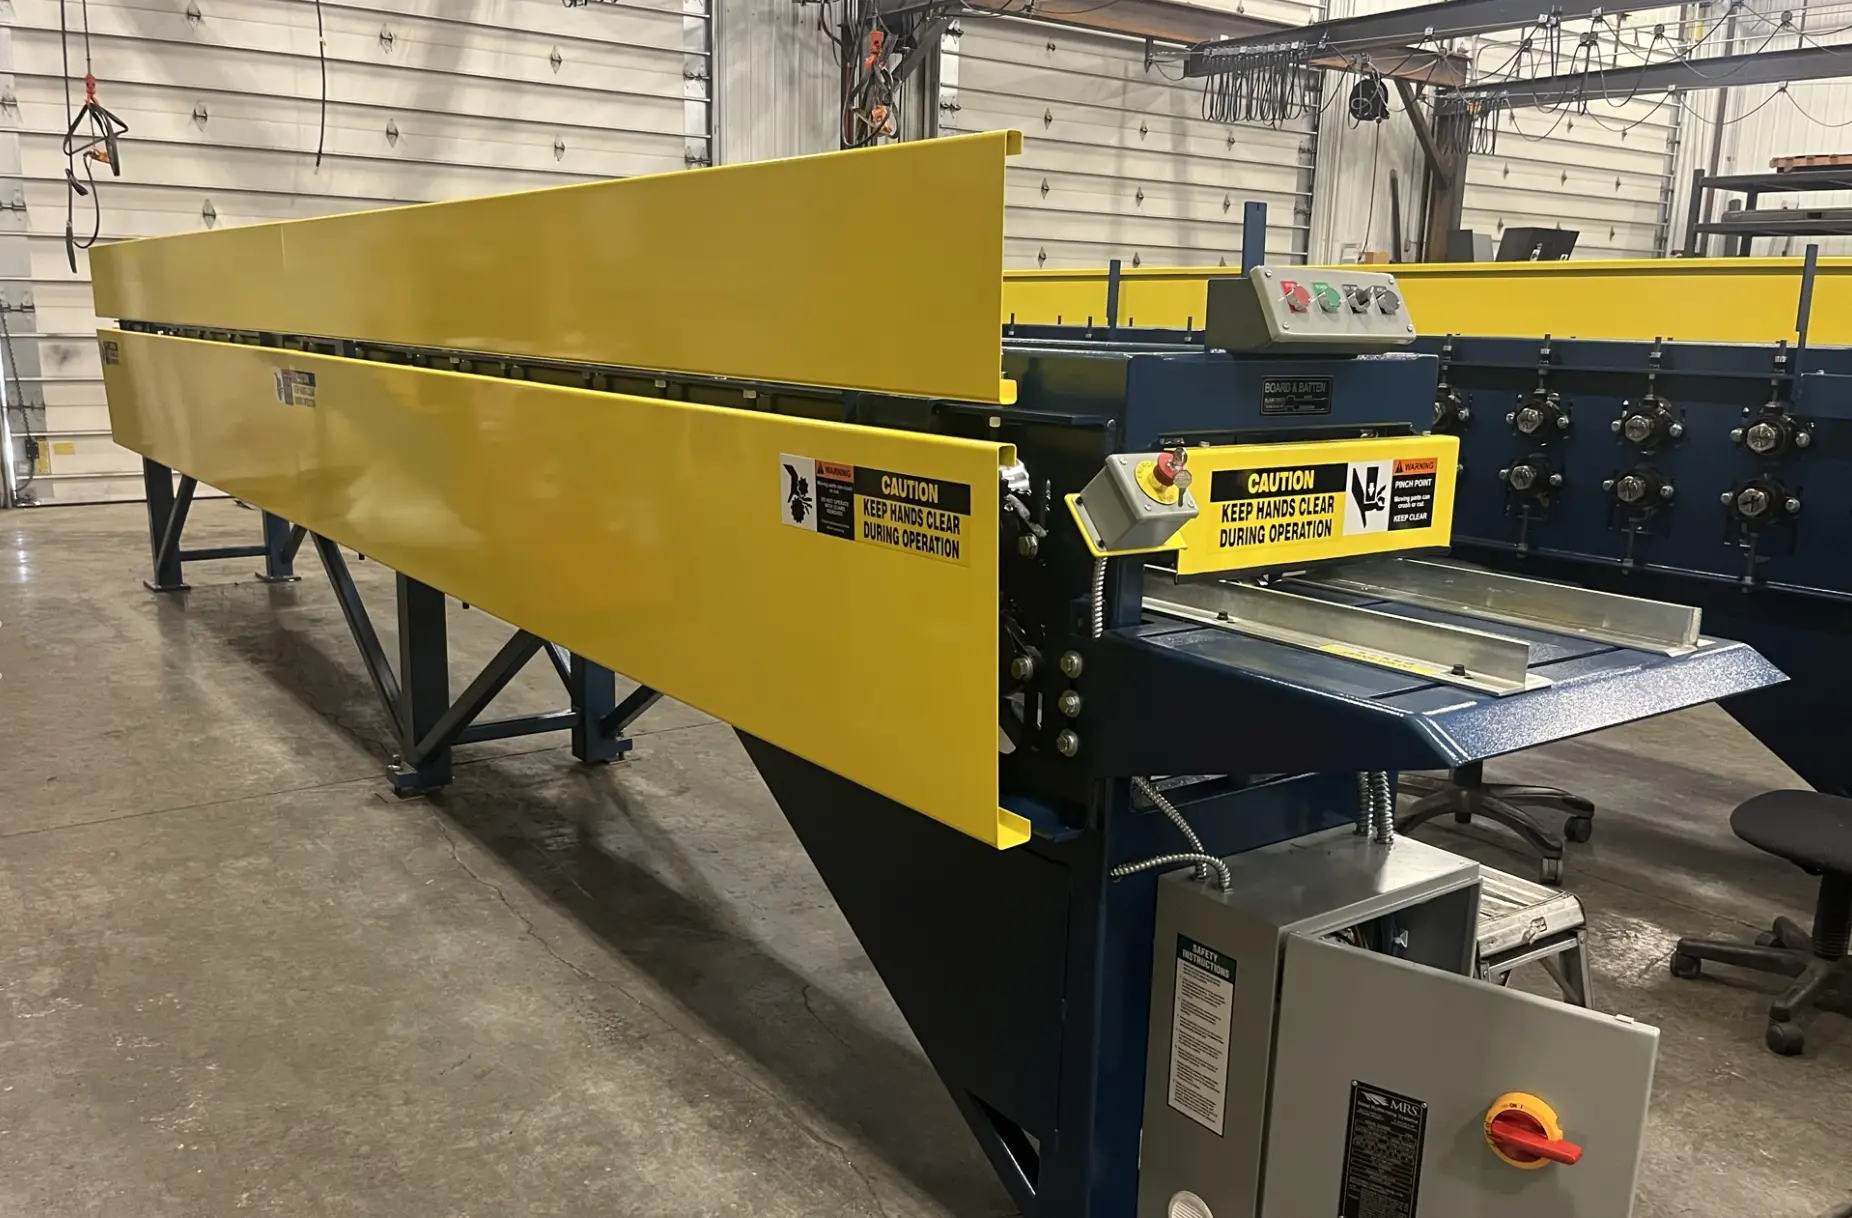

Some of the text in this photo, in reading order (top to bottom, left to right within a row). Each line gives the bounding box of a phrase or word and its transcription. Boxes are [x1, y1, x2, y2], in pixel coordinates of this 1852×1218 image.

[1265, 382, 1291, 393] BOARD
[1299, 382, 1326, 393] BATTEN
[825, 467, 851, 477] WARNING
[1405, 462, 1434, 471] WARNING
[881, 475, 939, 504] CAUTION
[1247, 470, 1315, 494] CAUTION
[1395, 479, 1432, 489] PINCH POINT
[863, 498, 960, 535] KEEP HANDS CLEAR
[1221, 495, 1335, 523] KEEP HANDS CLEAR
[1393, 512, 1428, 522] KEEP CLEAR
[863, 521, 960, 559] DURING OPERATION
[1219, 519, 1332, 548] DURING OPERATION
[1183, 949, 1230, 978] INSTRUCTIONS
[1193, 944, 1218, 962] SAFETY
[1390, 1100, 1418, 1116] MRS
